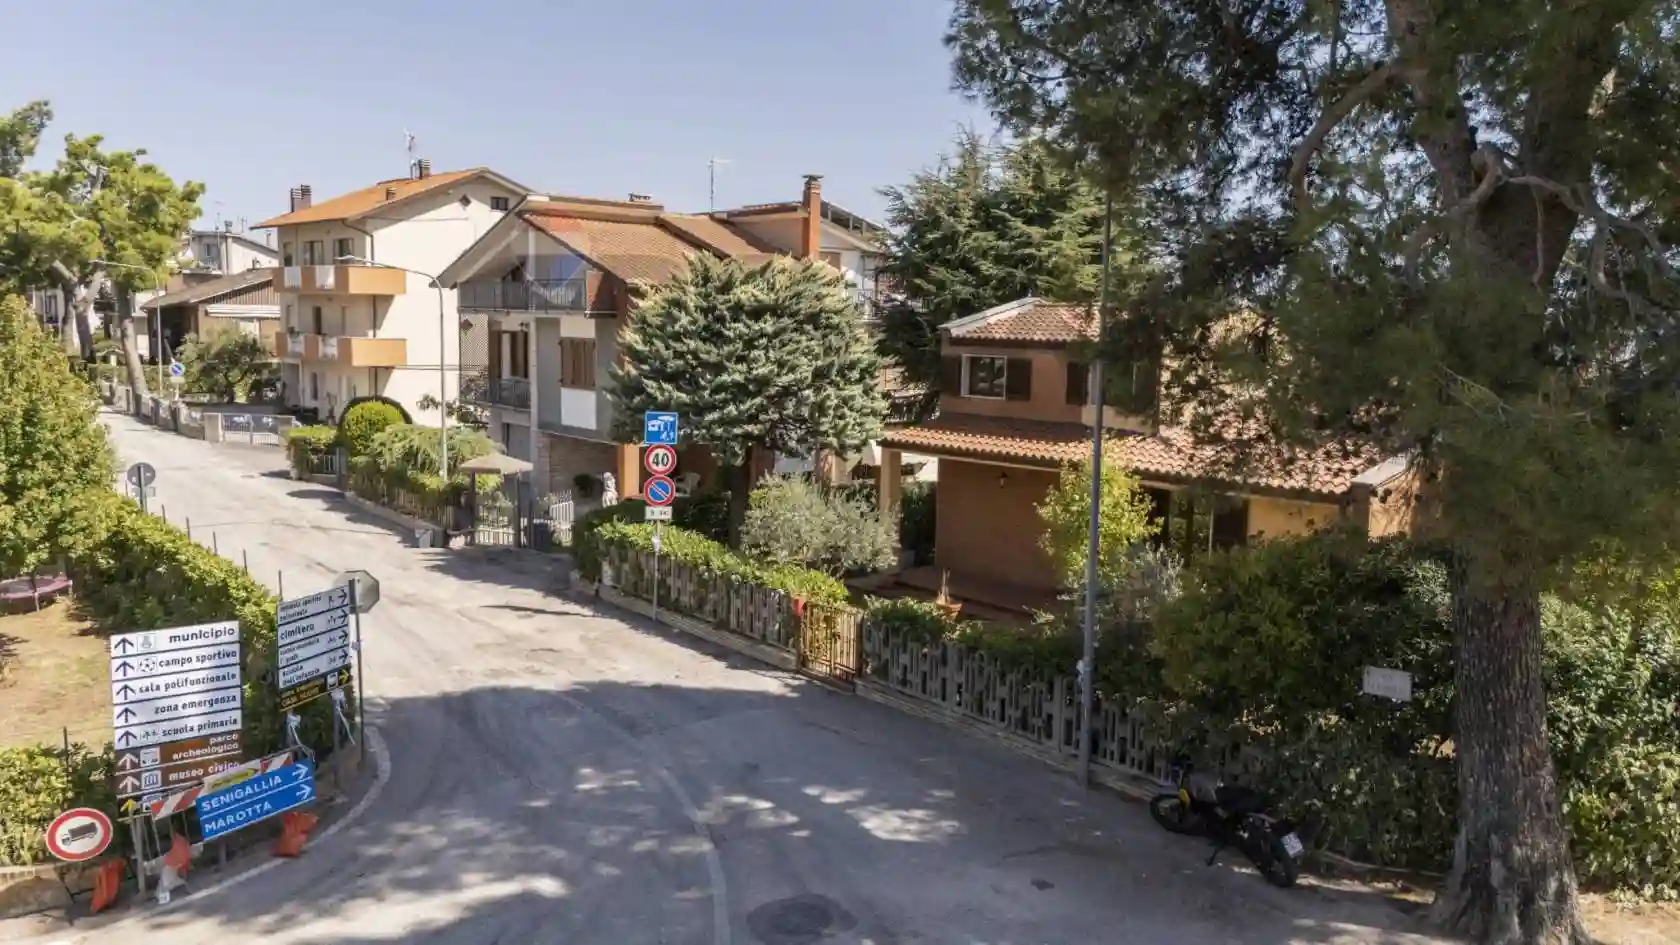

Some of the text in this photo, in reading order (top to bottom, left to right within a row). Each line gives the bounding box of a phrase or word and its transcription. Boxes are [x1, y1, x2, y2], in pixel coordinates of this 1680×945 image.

[652, 452, 670, 468] 40
[169, 627, 236, 644] municipio
[158, 649, 237, 668] campo sportivo
[139, 672, 237, 694] sala polifunzionale
[154, 694, 237, 715] zona emergenza
[162, 715, 238, 737] scuola primaria
[209, 733, 239, 745] parco
[172, 743, 239, 761] archeologico
[169, 767, 204, 781] museo
[202, 775, 282, 812] SENIGALLIA
[204, 802, 272, 832] MAROTTA
